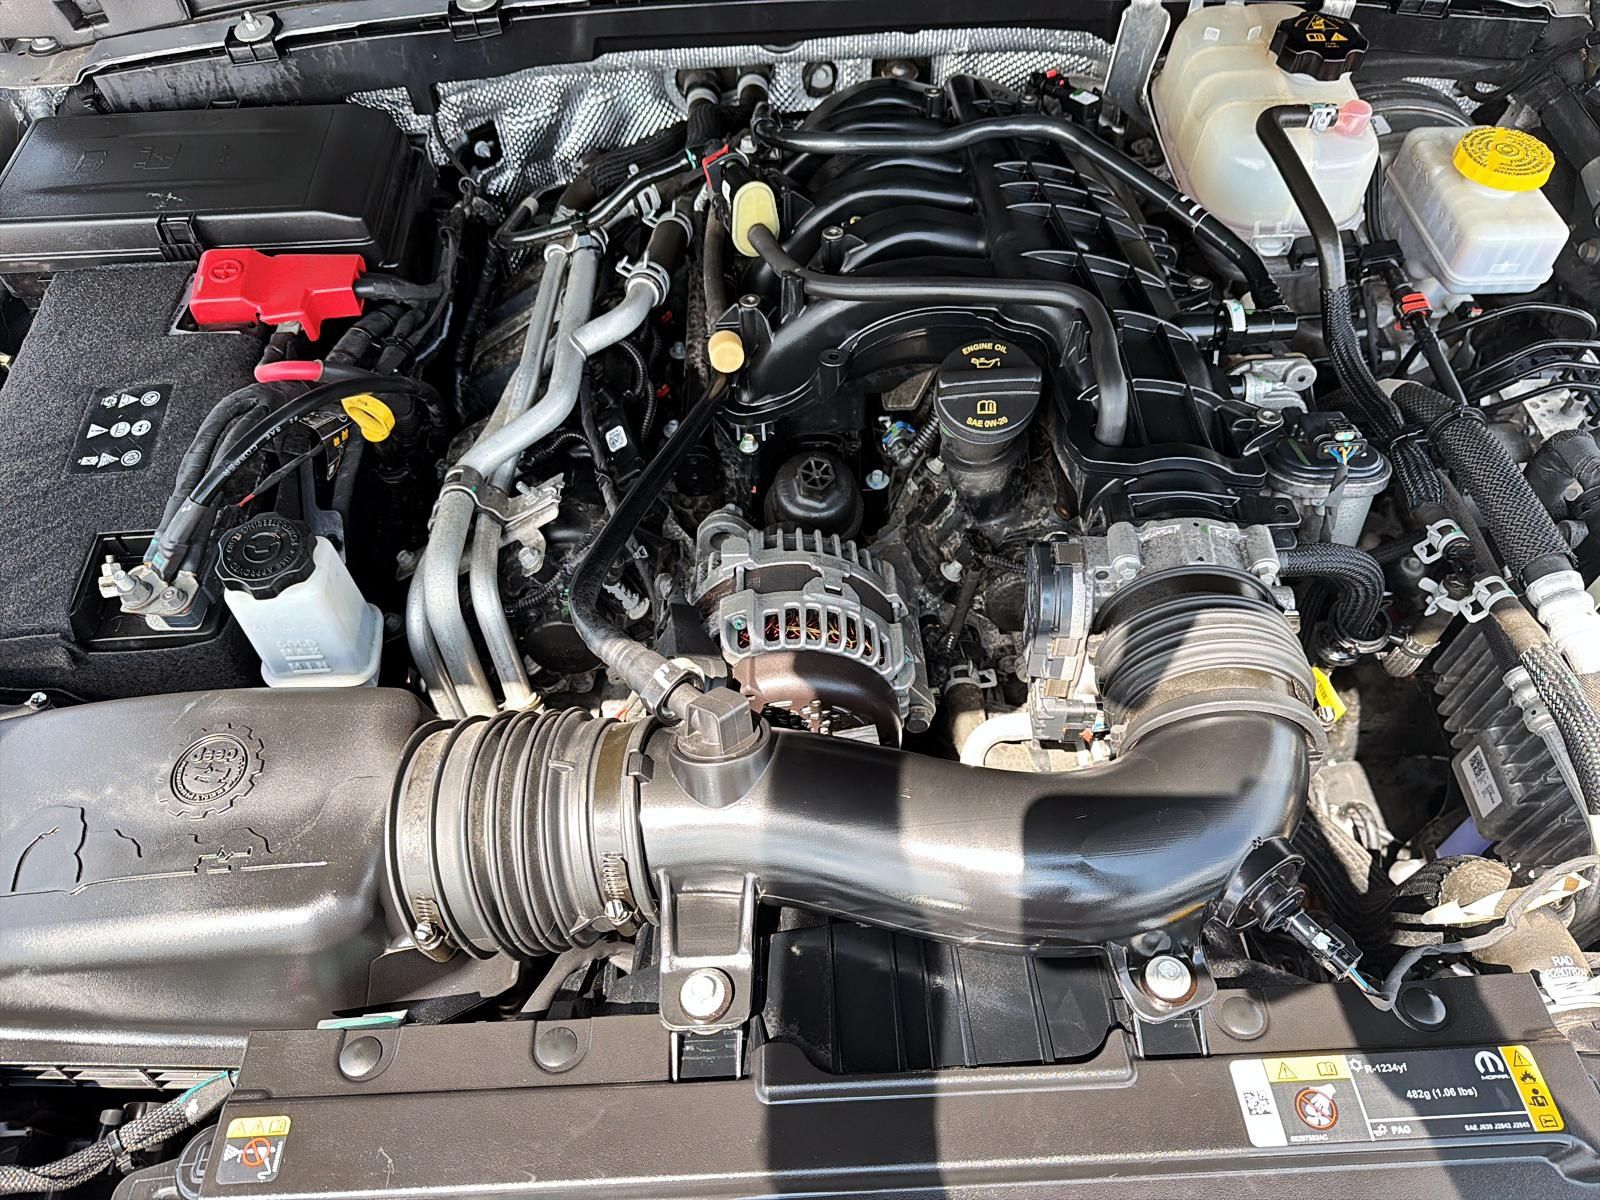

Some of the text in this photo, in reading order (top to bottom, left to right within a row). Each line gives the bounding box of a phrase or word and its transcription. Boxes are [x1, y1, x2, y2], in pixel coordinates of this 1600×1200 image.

[962, 343, 1008, 355] ENGINE OIL
[966, 416, 1008, 428] SAE 0W-20
[265, 427, 281, 441] SAE
[222, 445, 258, 477] COPPER
[240, 518, 282, 534] STEERING
[229, 554, 292, 577] USE APPROVED
[277, 639, 317, 648] COLD
[280, 647, 320, 656] MAX
[288, 661, 328, 671] MIN
[191, 747, 238, 763] Jeep
[1551, 955, 1573, 966] RAD
[1363, 1063, 1407, 1074] R-1234yf
[1406, 1086, 1478, 1100] 482g (1.06 lbs)
[1390, 1125, 1412, 1135] PAG
